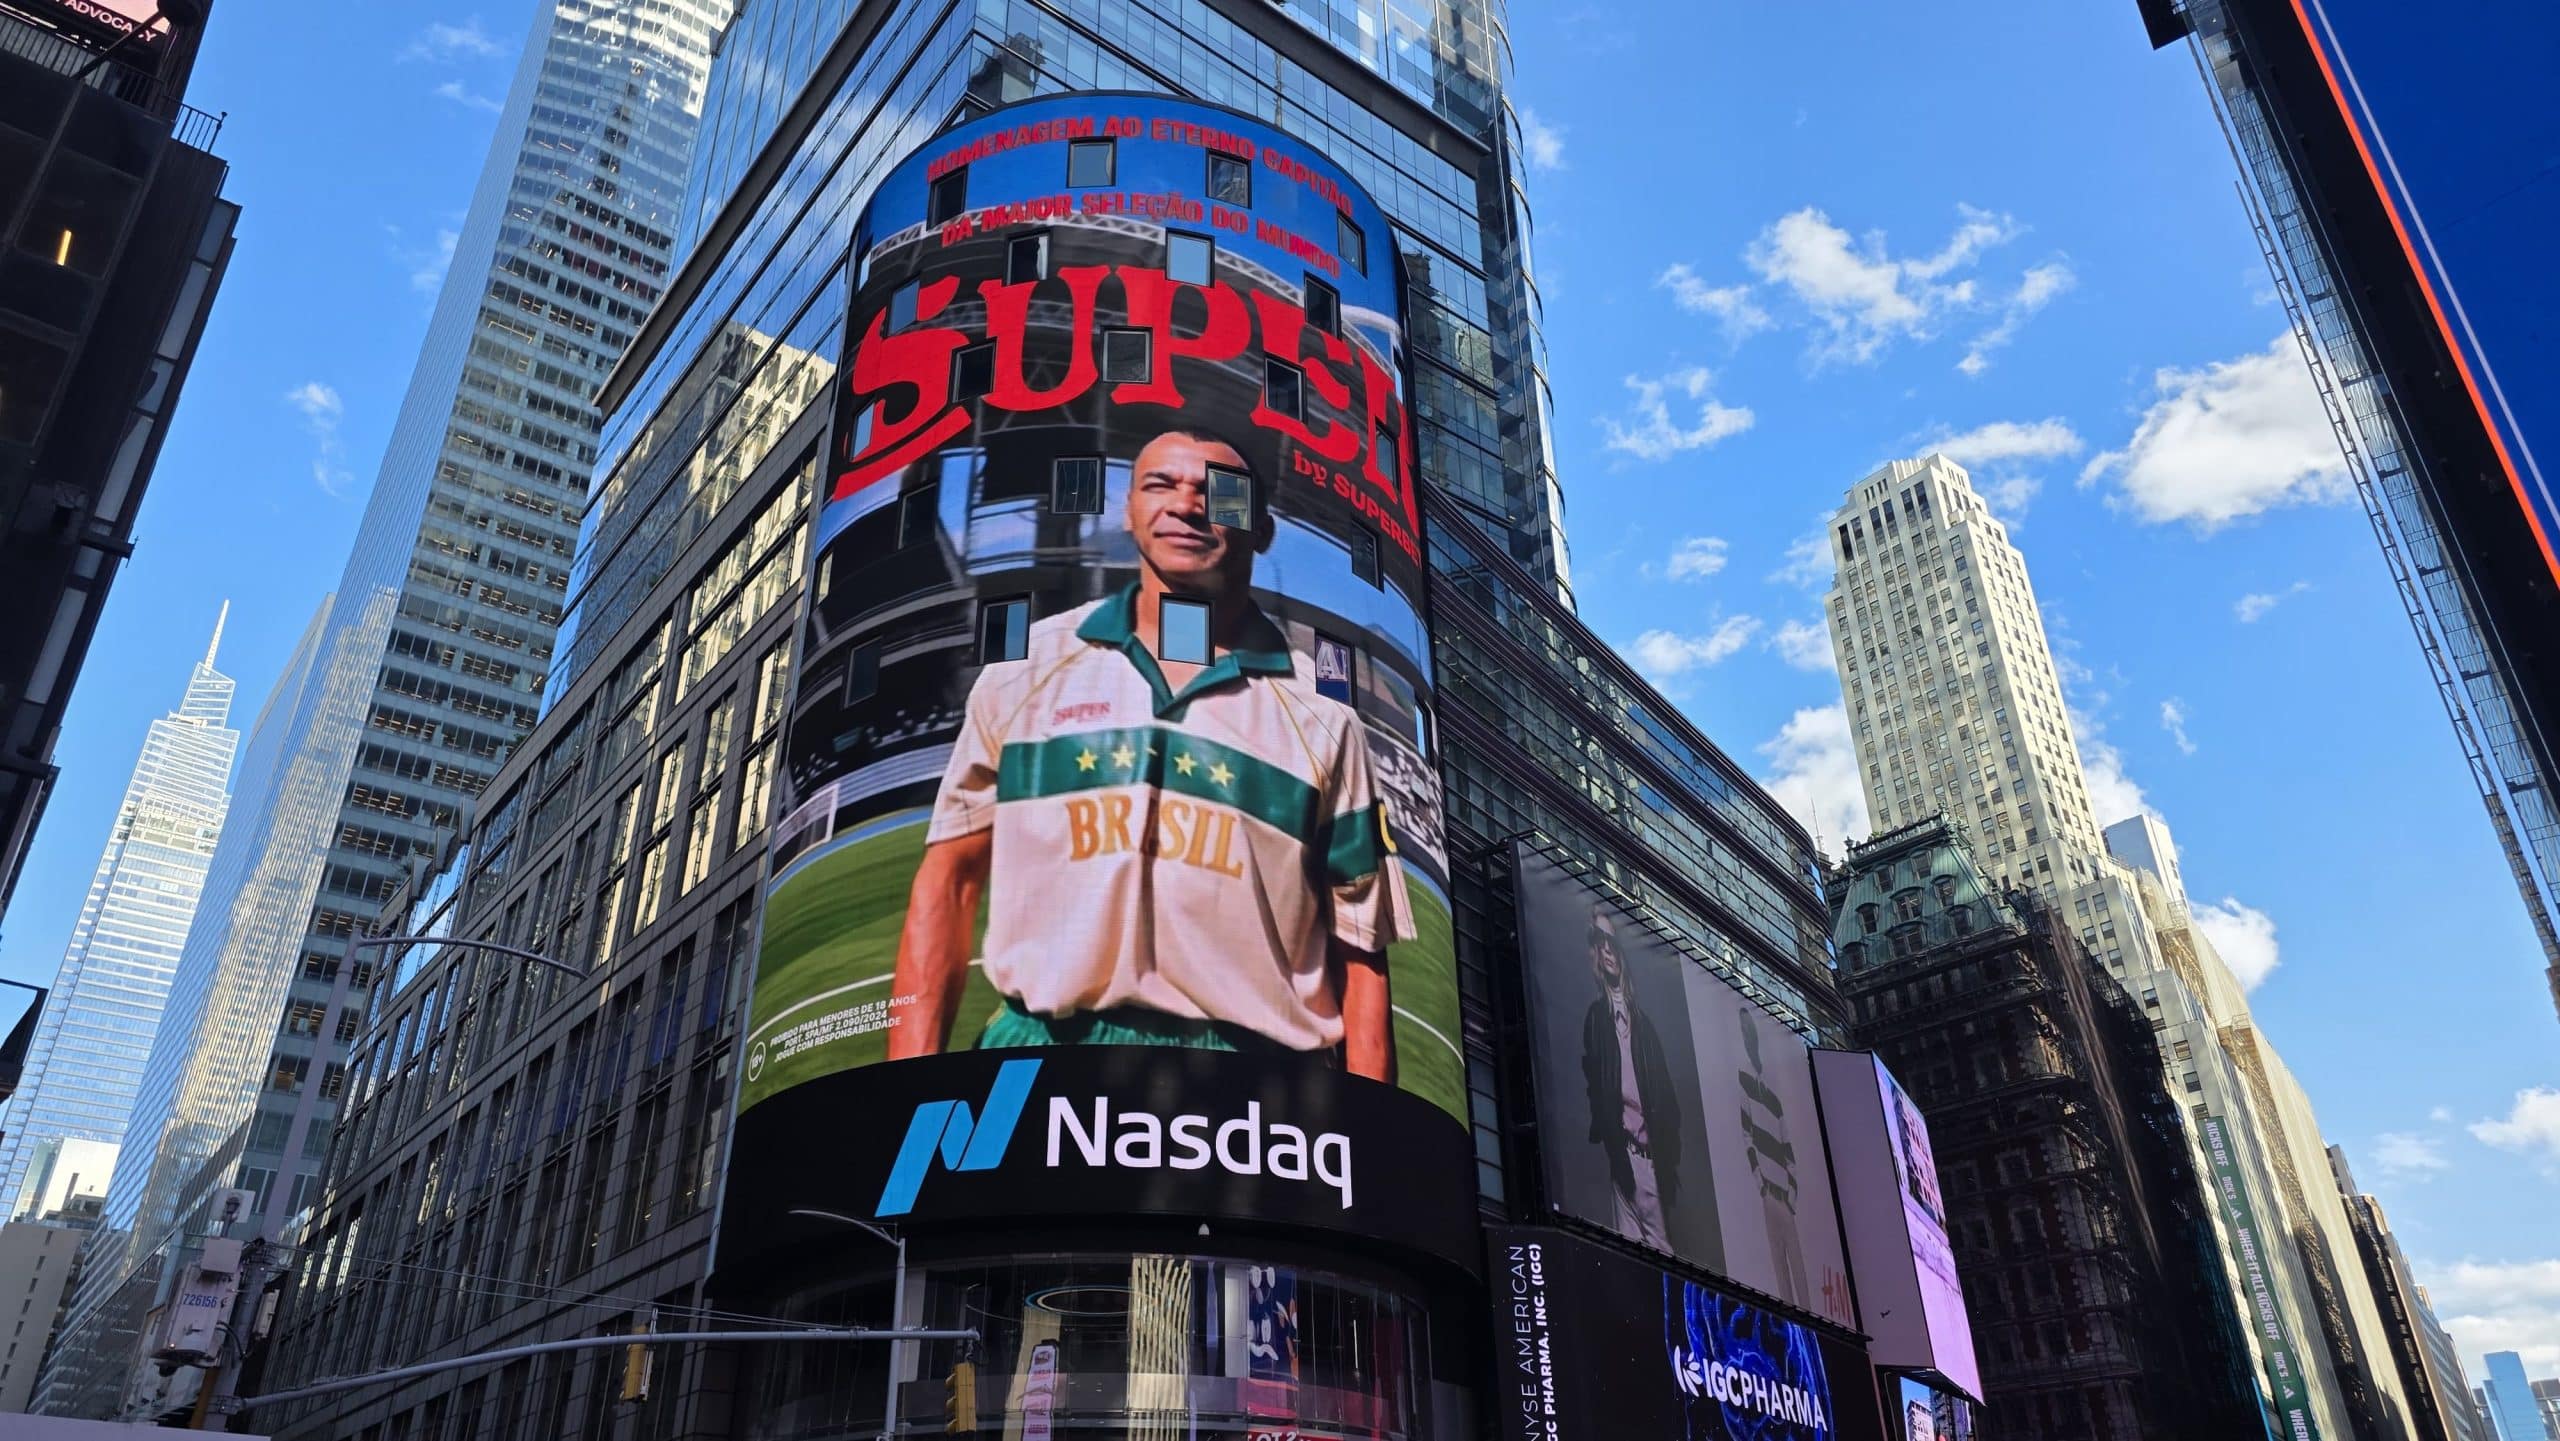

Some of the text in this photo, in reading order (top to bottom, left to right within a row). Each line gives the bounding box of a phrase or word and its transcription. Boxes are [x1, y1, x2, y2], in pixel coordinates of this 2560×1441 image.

[65, 0, 157, 42] ADVOCAY
[927, 115, 1354, 217] HOMENAGEM AO ETERNO CAPITÃO
[941, 191, 1341, 279] DA MAIOR SELEÇÃO DO MUNDO
[1065, 794, 1244, 880] BRSIL
[796, 1039, 814, 1053] COM
[815, 1016, 903, 1046] RESPONSABILIDADE
[799, 1019, 818, 1034] PARA
[819, 1006, 860, 1028] MENORES
[861, 1003, 874, 1014] DE
[875, 1000, 887, 1010] 18
[888, 994, 918, 1009] ANOS
[1047, 1096, 1353, 1210] Nasdaq
[2206, 1121, 2229, 1167] KICKS OFF
[1528, 1244, 1545, 1286] (IGC)
[183, 1293, 218, 1308] 726156
[1509, 1246, 1535, 1374] AMERICAN
[1534, 1291, 1548, 1326] INC.
[2256, 1292, 2275, 1321] KICKS
[2264, 1322, 2280, 1341] OFF
[1538, 1331, 1557, 1415] PHARMA,
